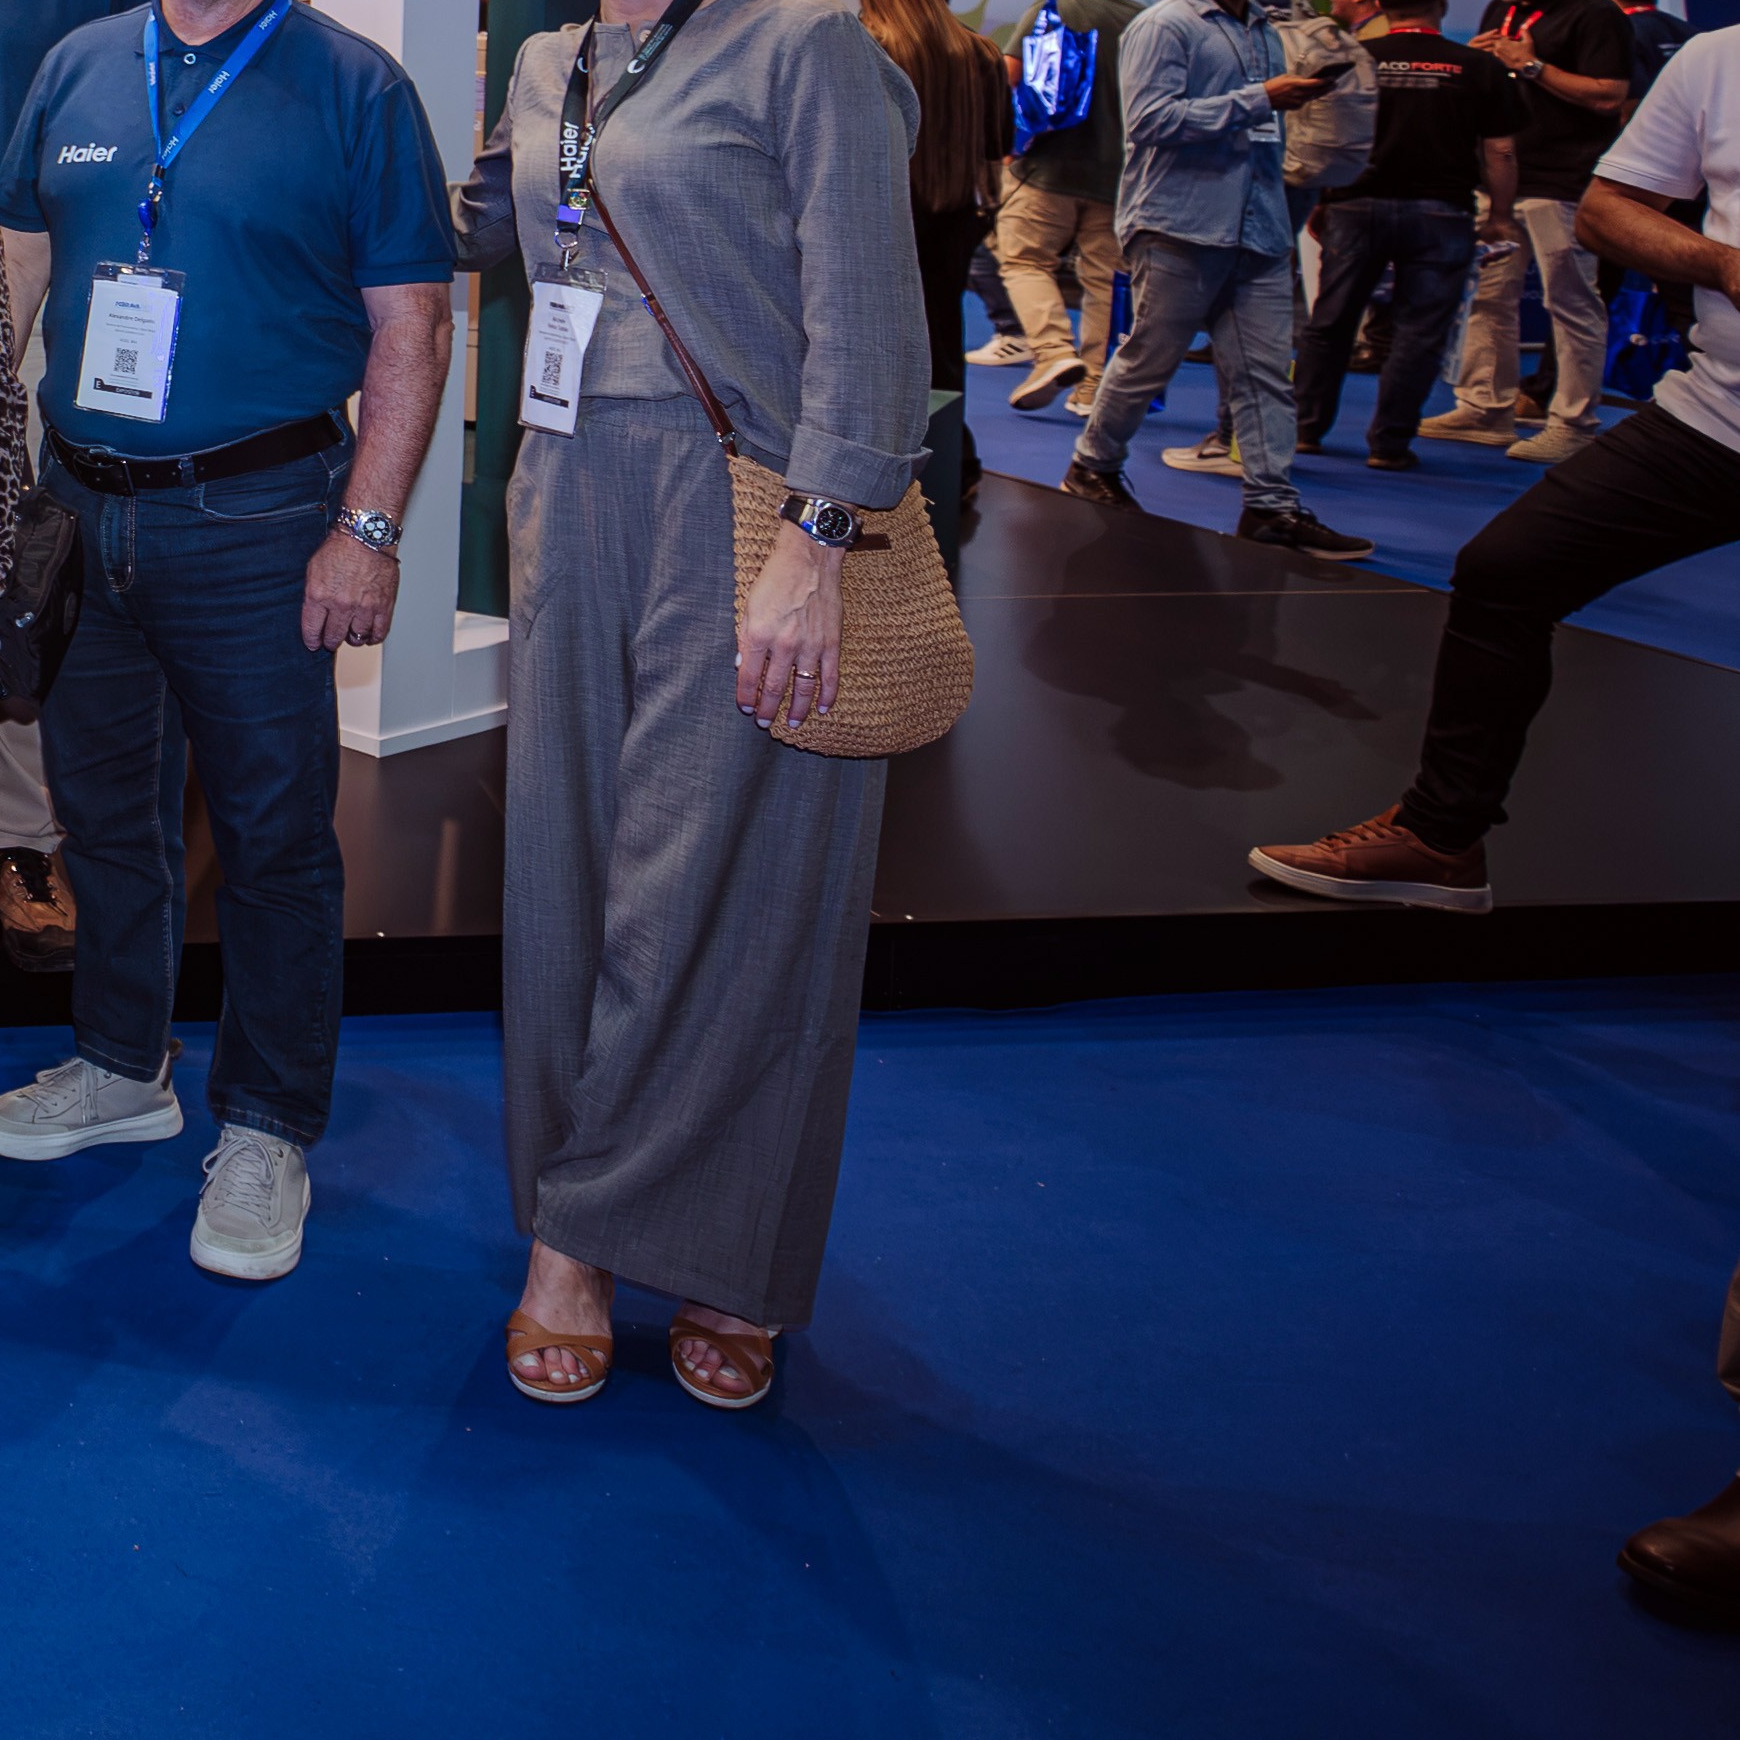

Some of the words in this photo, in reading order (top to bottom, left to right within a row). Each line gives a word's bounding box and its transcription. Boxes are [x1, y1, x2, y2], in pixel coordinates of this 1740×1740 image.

[259, 10, 278, 31] Haier
[208, 70, 230, 94] Haier
[57, 143, 118, 164] Haier
[560, 121, 579, 171] Haier
